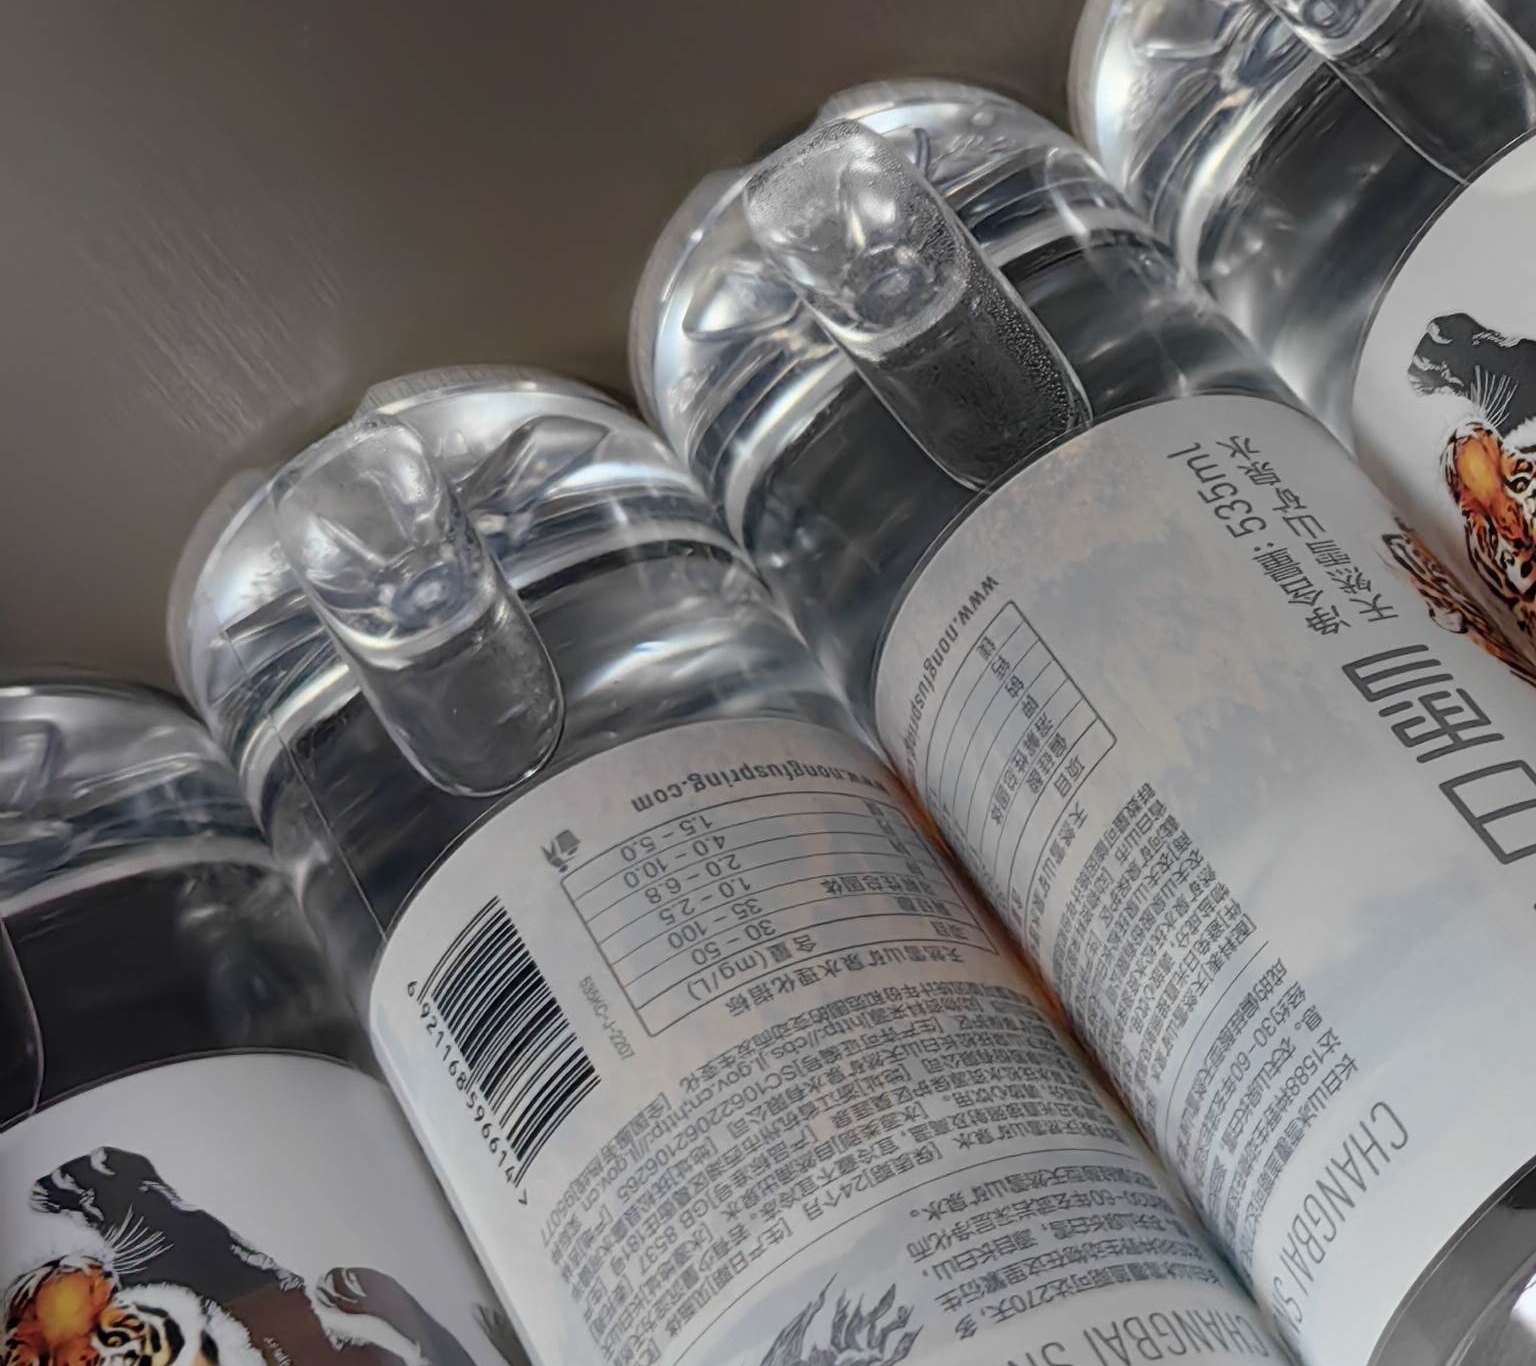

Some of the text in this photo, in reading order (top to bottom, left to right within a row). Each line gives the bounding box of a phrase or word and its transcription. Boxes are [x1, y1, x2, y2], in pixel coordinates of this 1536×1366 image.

[1215, 435, 1399, 624] 天然雪山矿泉水
[1051, 755, 1085, 798] 项目
[1279, 1101, 1409, 1297] CHANGBAI
[1082, 1313, 1265, 1366] CHANGBAI
